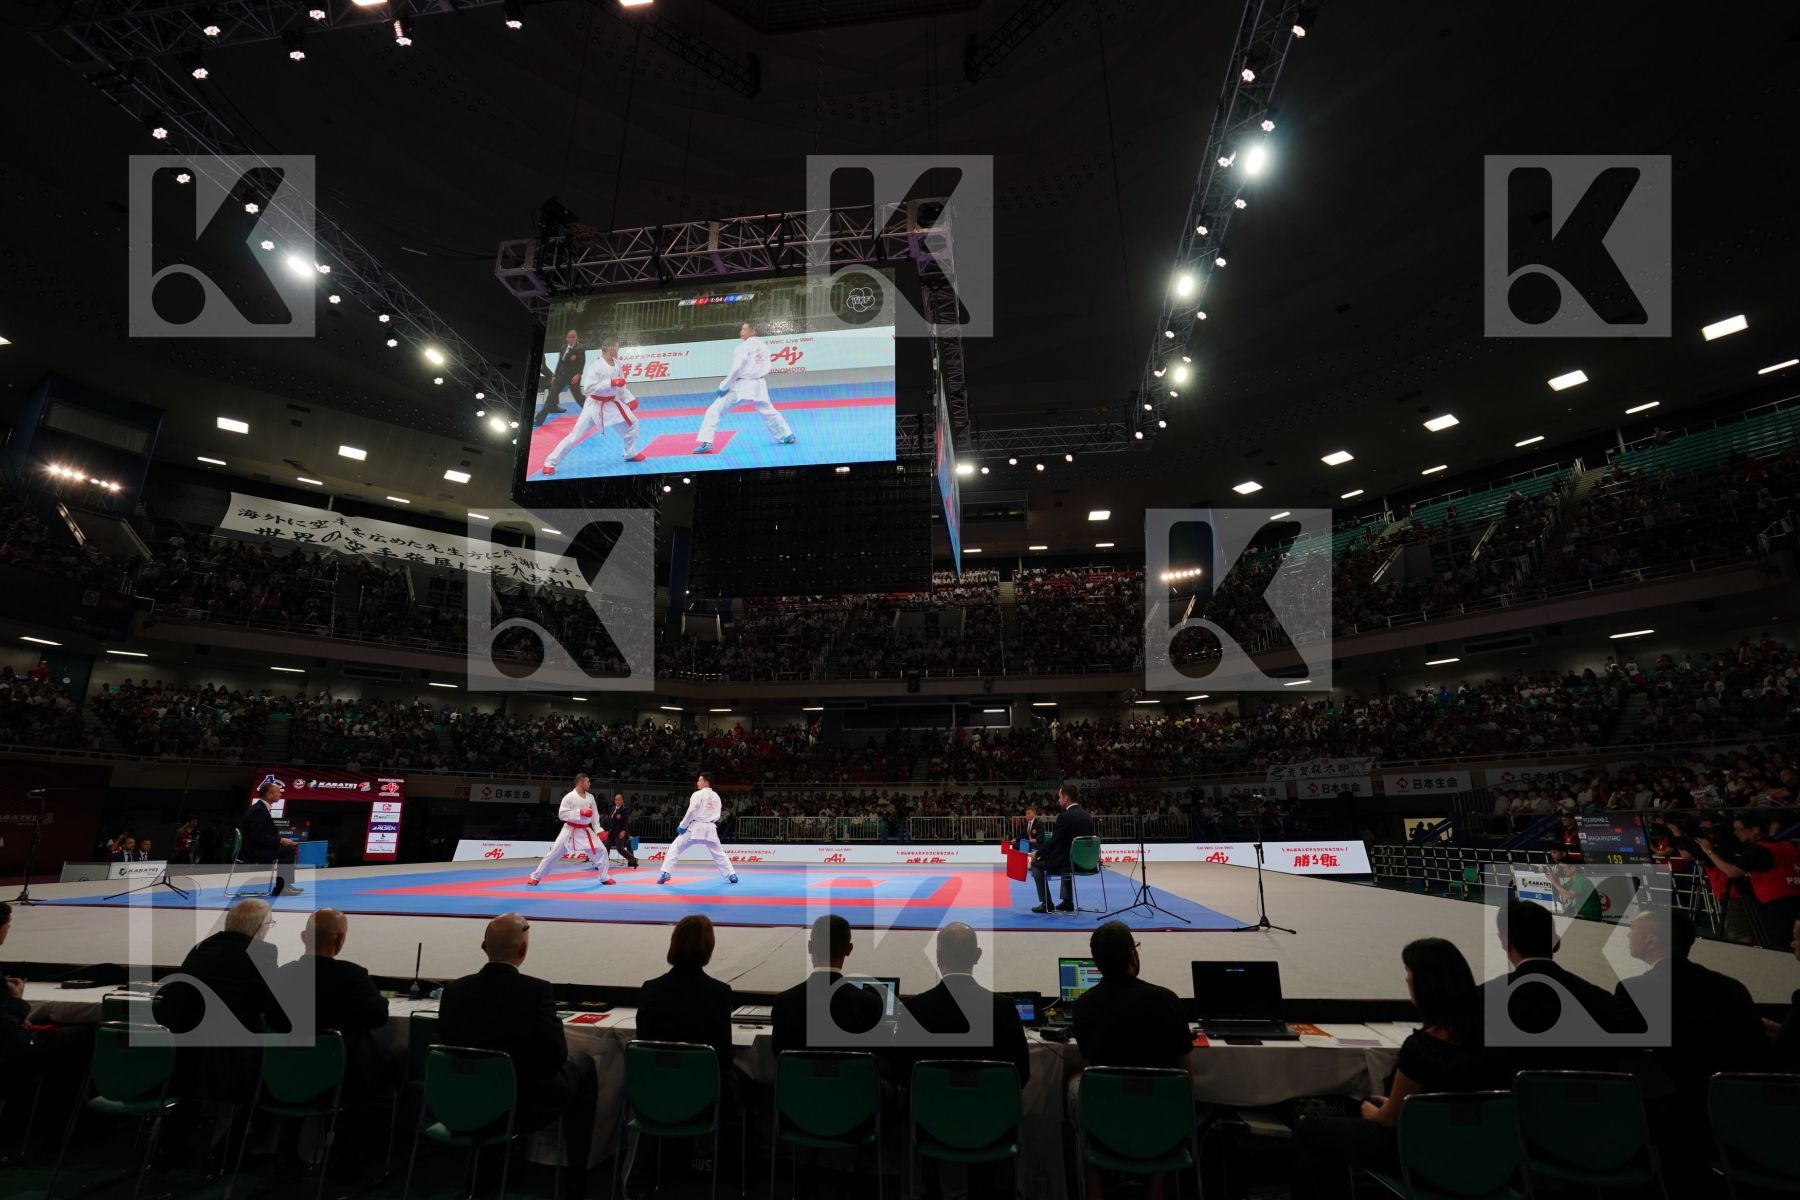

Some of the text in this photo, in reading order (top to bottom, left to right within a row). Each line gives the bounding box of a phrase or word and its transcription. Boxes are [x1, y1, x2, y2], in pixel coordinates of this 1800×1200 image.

[1322, 782, 1361, 794] 日本生命
[1413, 777, 1458, 790] 日本生命
[495, 789, 531, 799] 日本生命
[1293, 853, 1340, 868] 勝ち飯
[1607, 853, 1623, 864] 1:53
